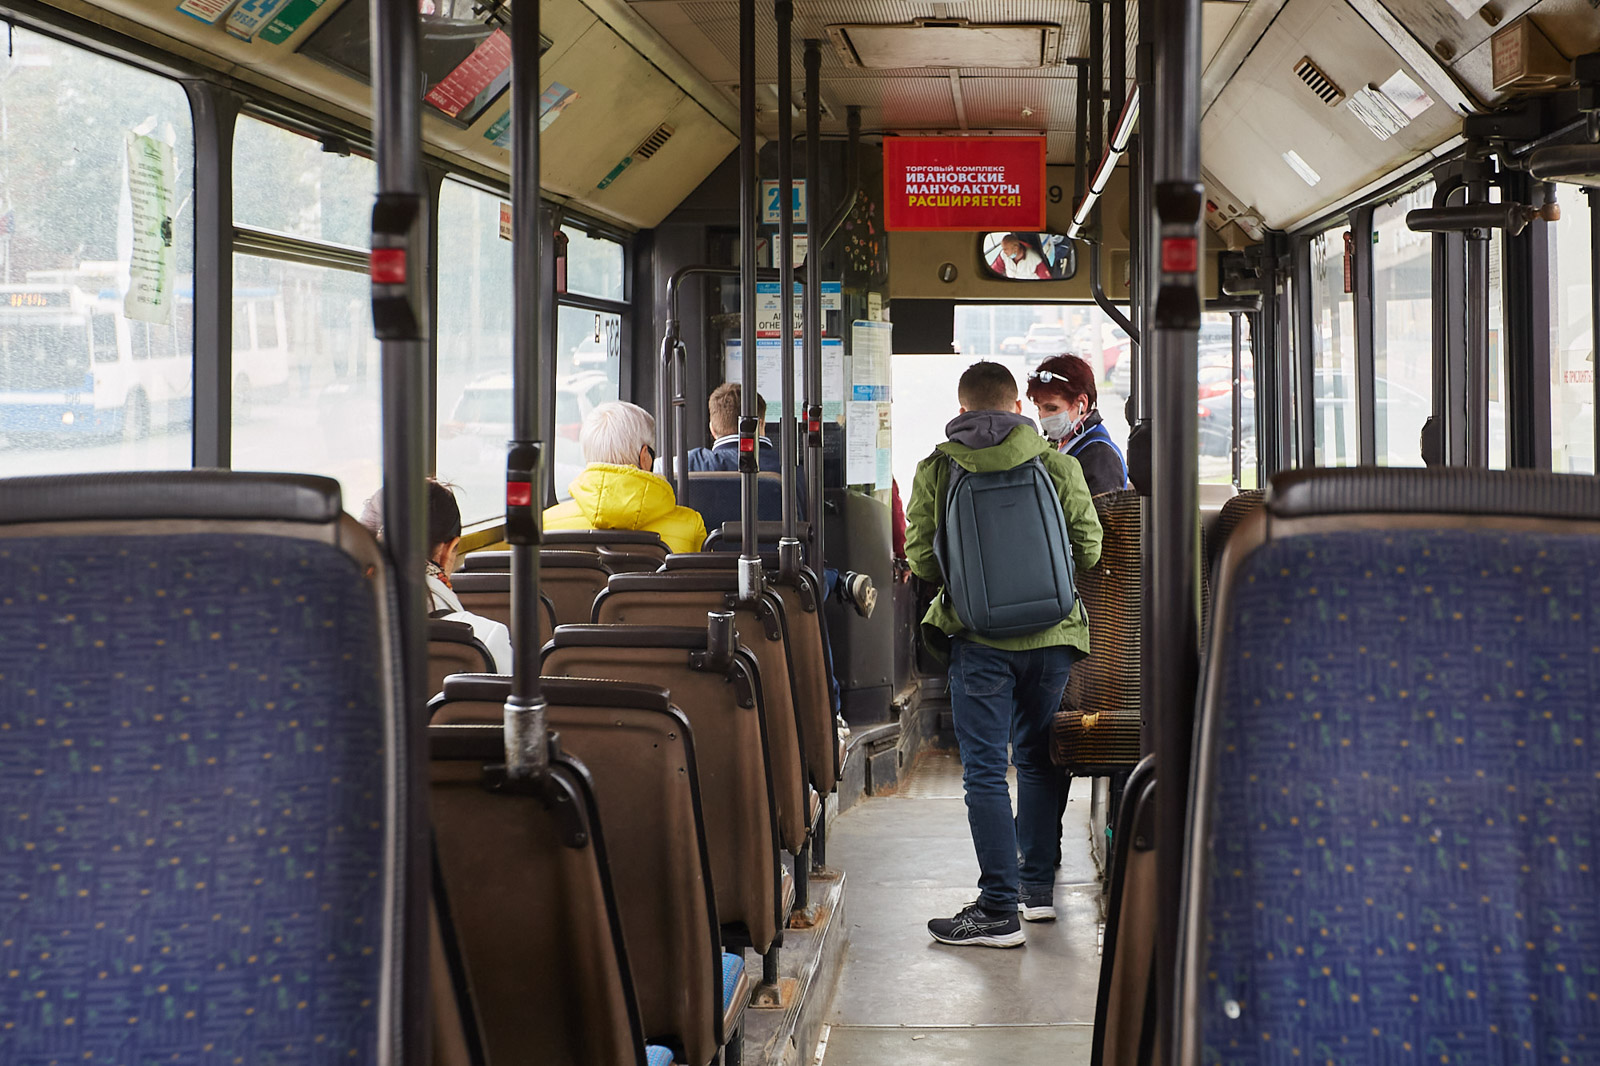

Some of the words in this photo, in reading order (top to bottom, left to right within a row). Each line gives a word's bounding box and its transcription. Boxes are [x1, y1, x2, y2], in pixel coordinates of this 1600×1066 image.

[905, 173, 1006, 183] ИВАНОВСКИЕ
[905, 184, 1021, 194] МАНУФАКТУРЫ
[908, 195, 1022, 207] РАСШИРЯЕТСЯ!
